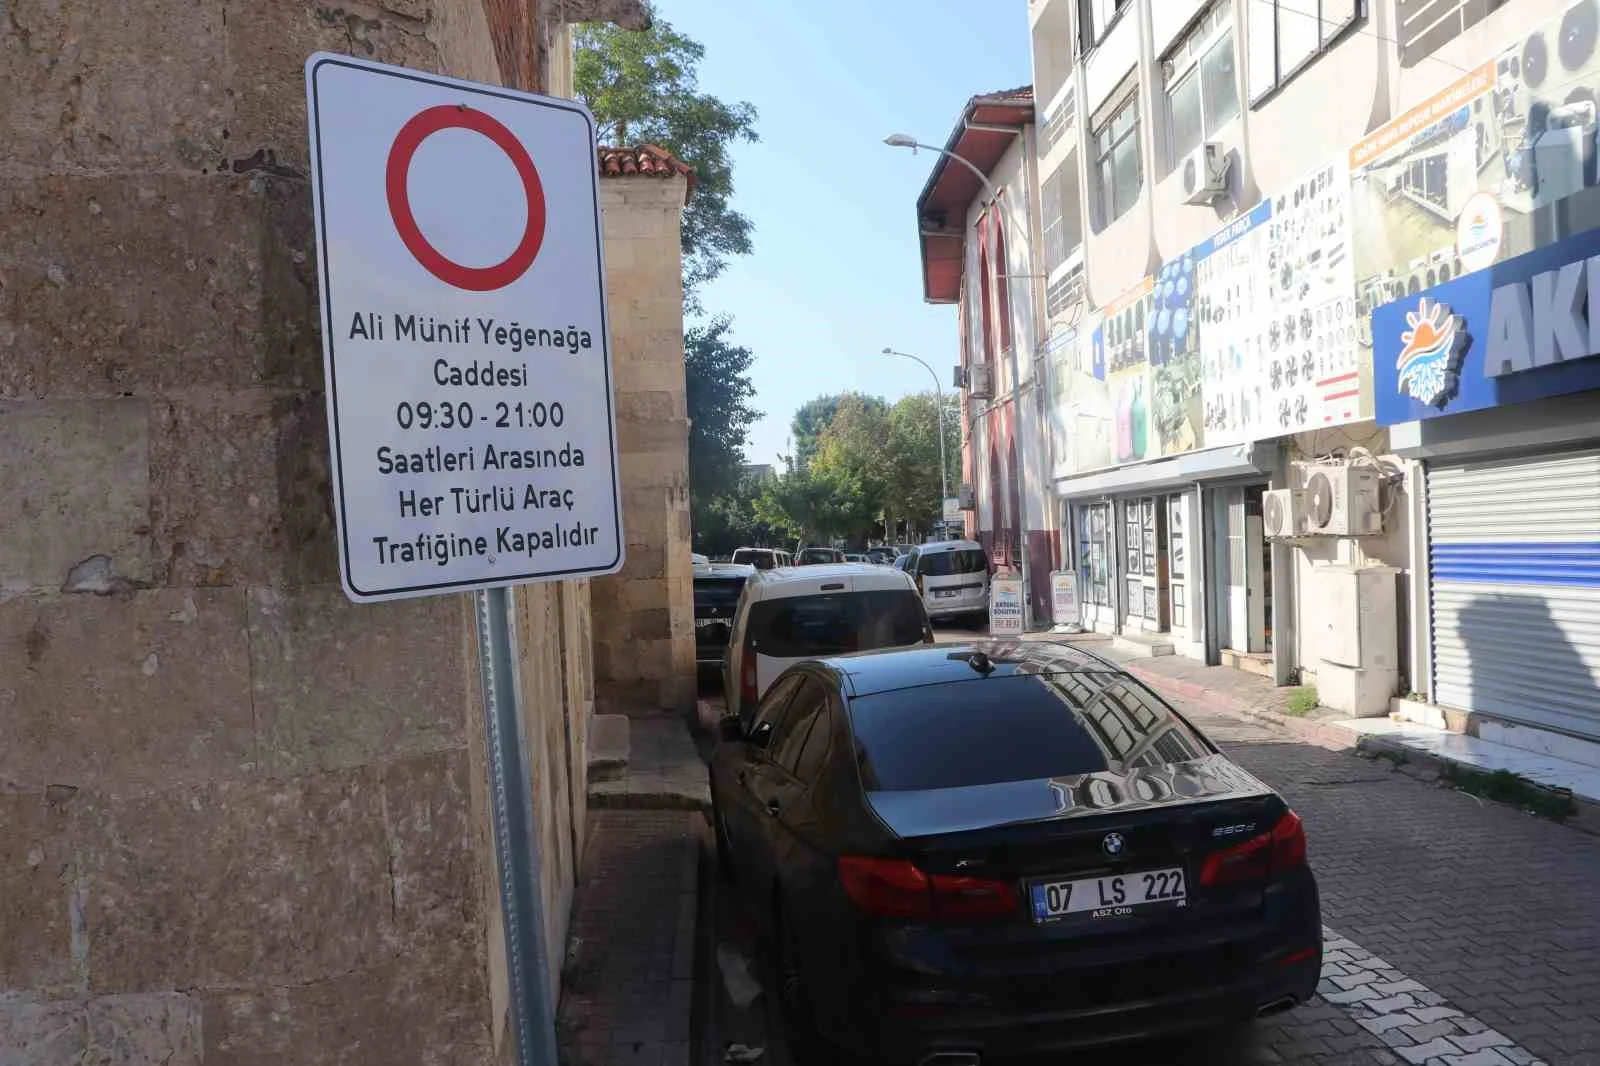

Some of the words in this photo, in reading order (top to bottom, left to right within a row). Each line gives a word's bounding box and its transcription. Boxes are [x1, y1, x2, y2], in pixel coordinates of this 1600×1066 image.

[350, 312, 383, 341] Ali
[395, 314, 470, 344] Münif
[477, 318, 592, 354] Yeğenağa
[1484, 254, 1600, 378] AK
[434, 359, 528, 386] Caddesi
[397, 401, 473, 430] 09:30
[495, 402, 564, 428] 21:00
[377, 446, 474, 475] Saatleri
[483, 442, 585, 470] Arasında
[400, 490, 444, 518] Her
[451, 486, 514, 515] Türlü
[523, 484, 574, 511] Araç
[373, 533, 488, 566] Trafiğine
[496, 521, 599, 558] Kapalıdır
[1047, 884, 1072, 912] 07
[1098, 878, 1125, 906] LS
[1143, 871, 1184, 900] 222
[1114, 907, 1132, 916] Oto
